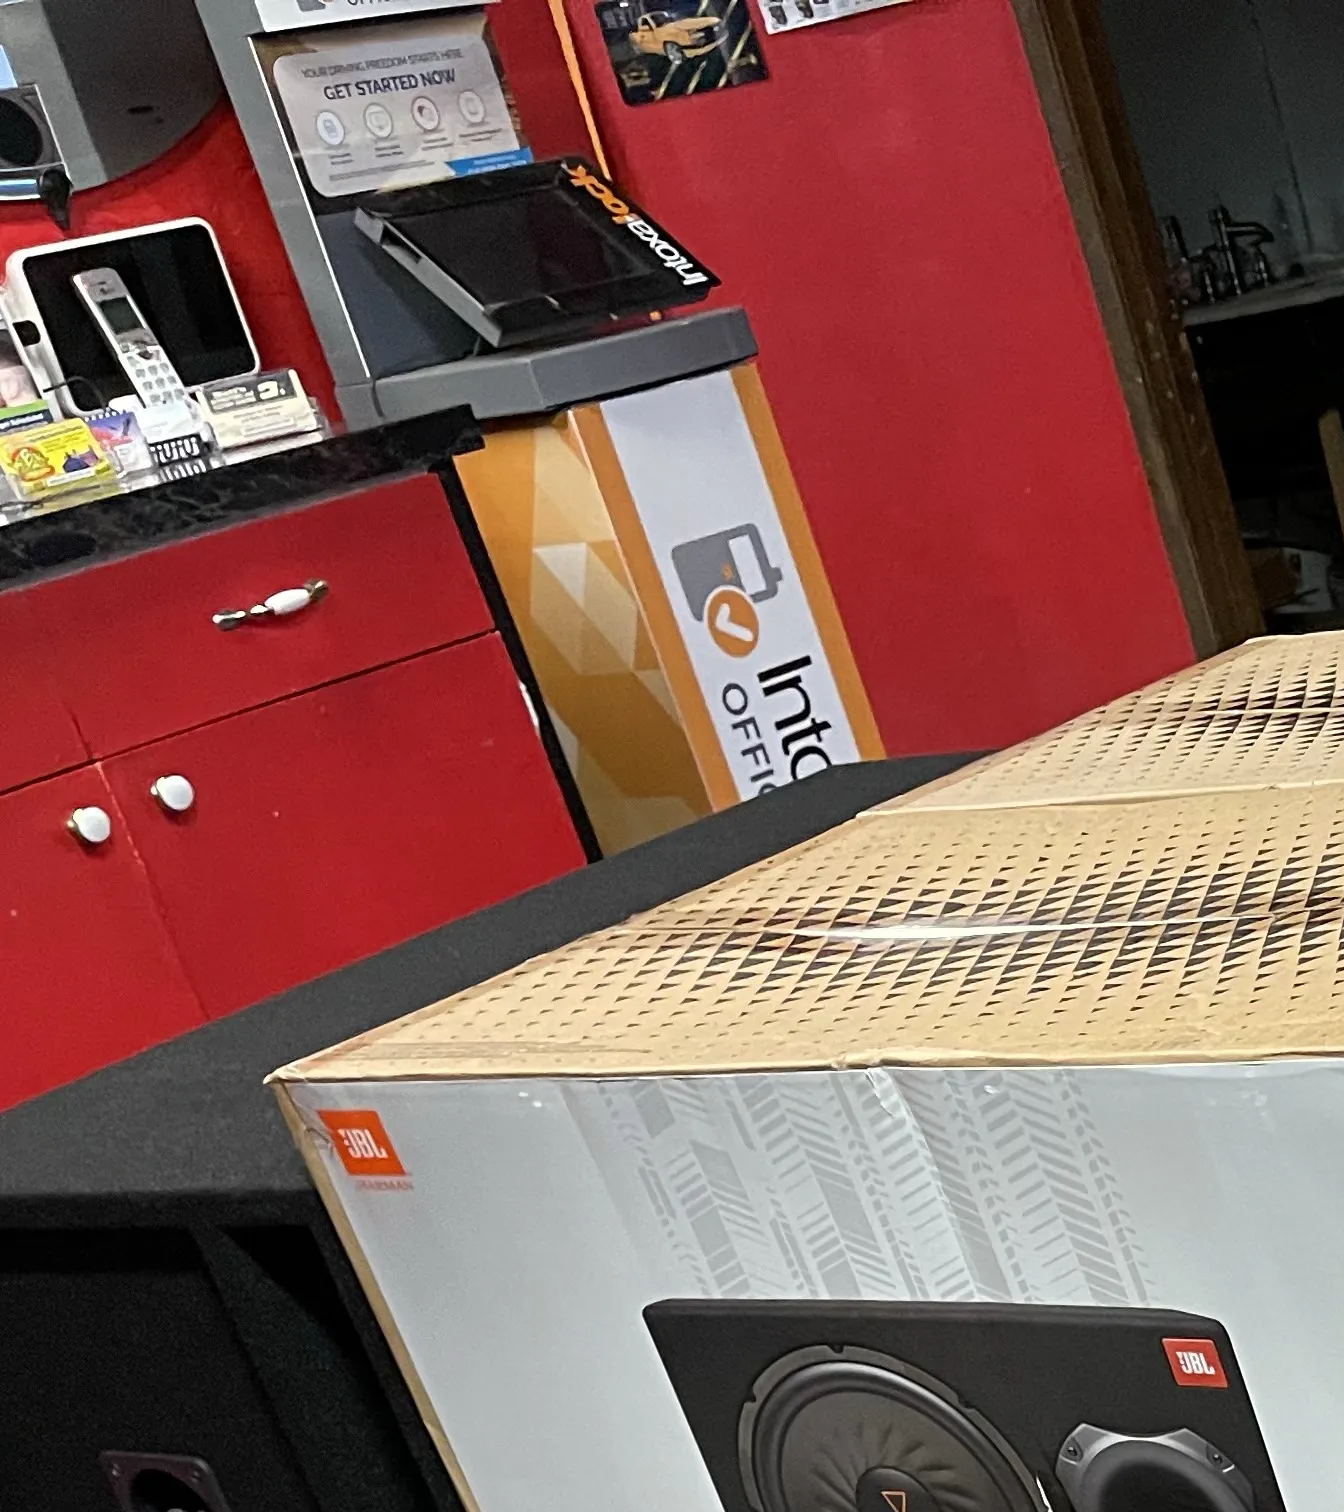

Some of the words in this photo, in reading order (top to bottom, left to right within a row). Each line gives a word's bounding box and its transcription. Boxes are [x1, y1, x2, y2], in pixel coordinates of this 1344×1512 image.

[323, 82, 352, 100] GET
[356, 74, 419, 96] STARTED
[421, 68, 457, 86] NOW
[338, 1128, 388, 1158] JBL
[1175, 1351, 1215, 1376] JBL
